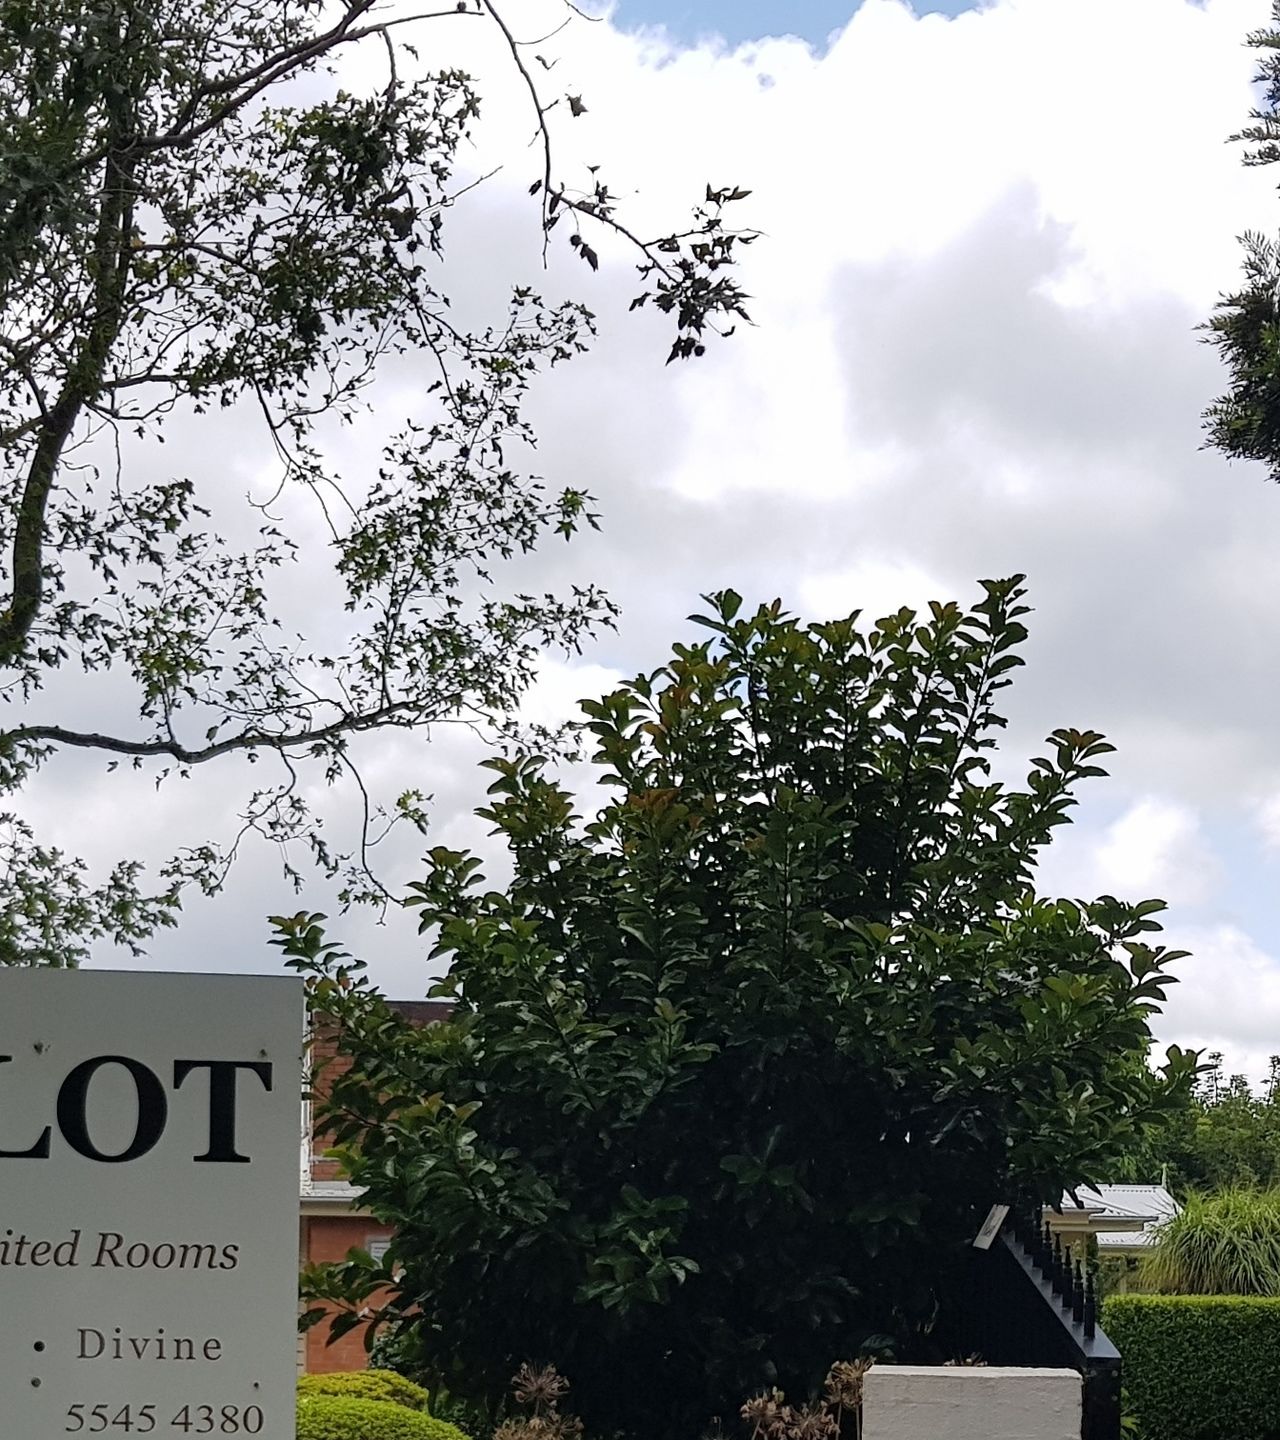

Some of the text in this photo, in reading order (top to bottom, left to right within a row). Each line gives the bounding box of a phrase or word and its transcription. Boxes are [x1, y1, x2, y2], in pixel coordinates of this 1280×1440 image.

[90, 1231, 240, 1270] Rooms
[76, 1327, 222, 1361] Divine
[64, 1403, 264, 1434] 5545 4380
